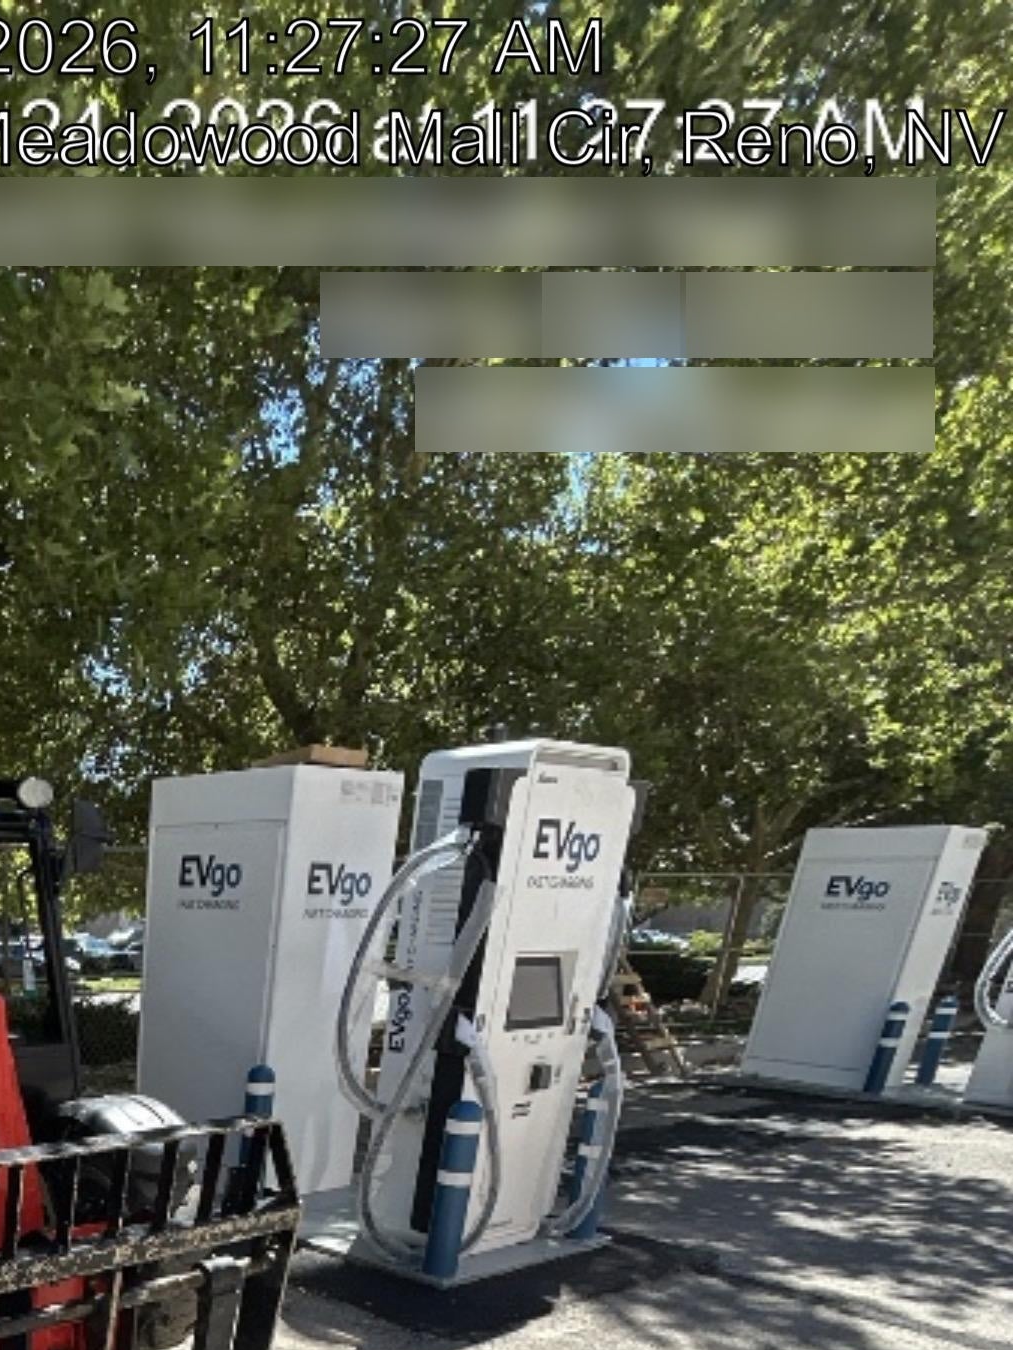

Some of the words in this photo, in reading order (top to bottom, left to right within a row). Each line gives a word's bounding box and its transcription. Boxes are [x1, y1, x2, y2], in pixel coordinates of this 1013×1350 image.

[533, 818, 601, 873] EVgo
[179, 855, 242, 897] EVgo
[308, 862, 371, 906] EVgo
[824, 875, 890, 901] EVgo
